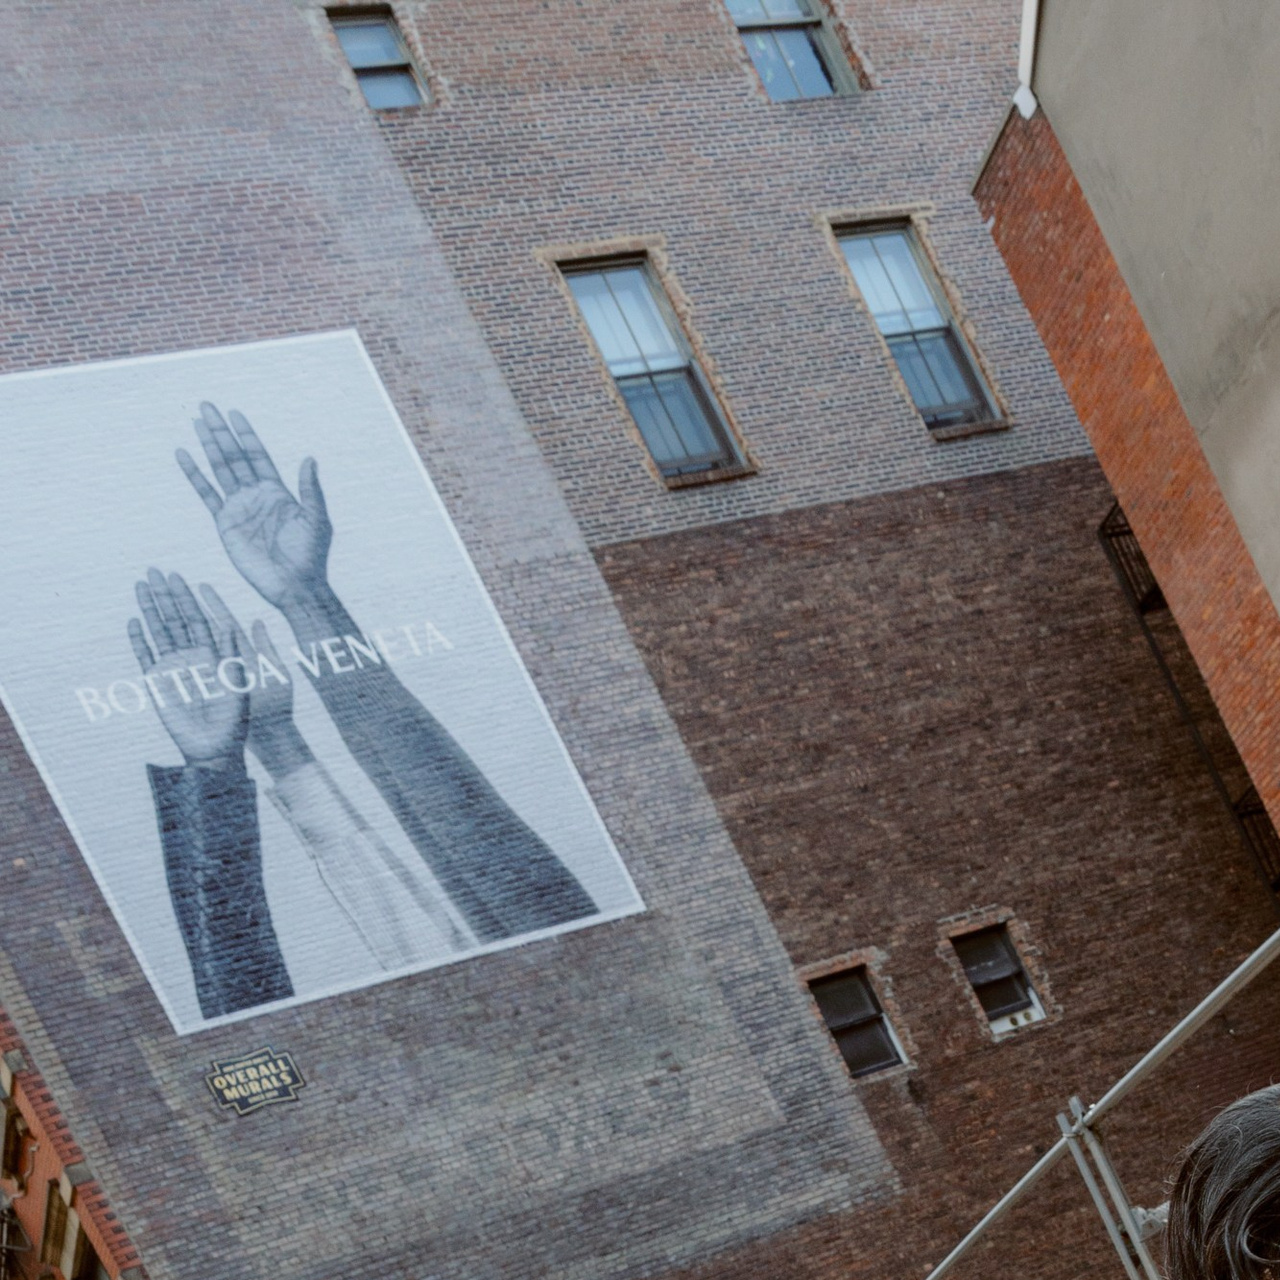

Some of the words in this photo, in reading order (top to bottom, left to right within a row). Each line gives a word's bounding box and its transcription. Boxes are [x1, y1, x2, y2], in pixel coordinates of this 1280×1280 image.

[74, 652, 290, 723] BOTTEGA
[290, 620, 455, 679] VENETA
[213, 1058, 290, 1090] OVERALL
[222, 1072, 293, 1102] MURALS
